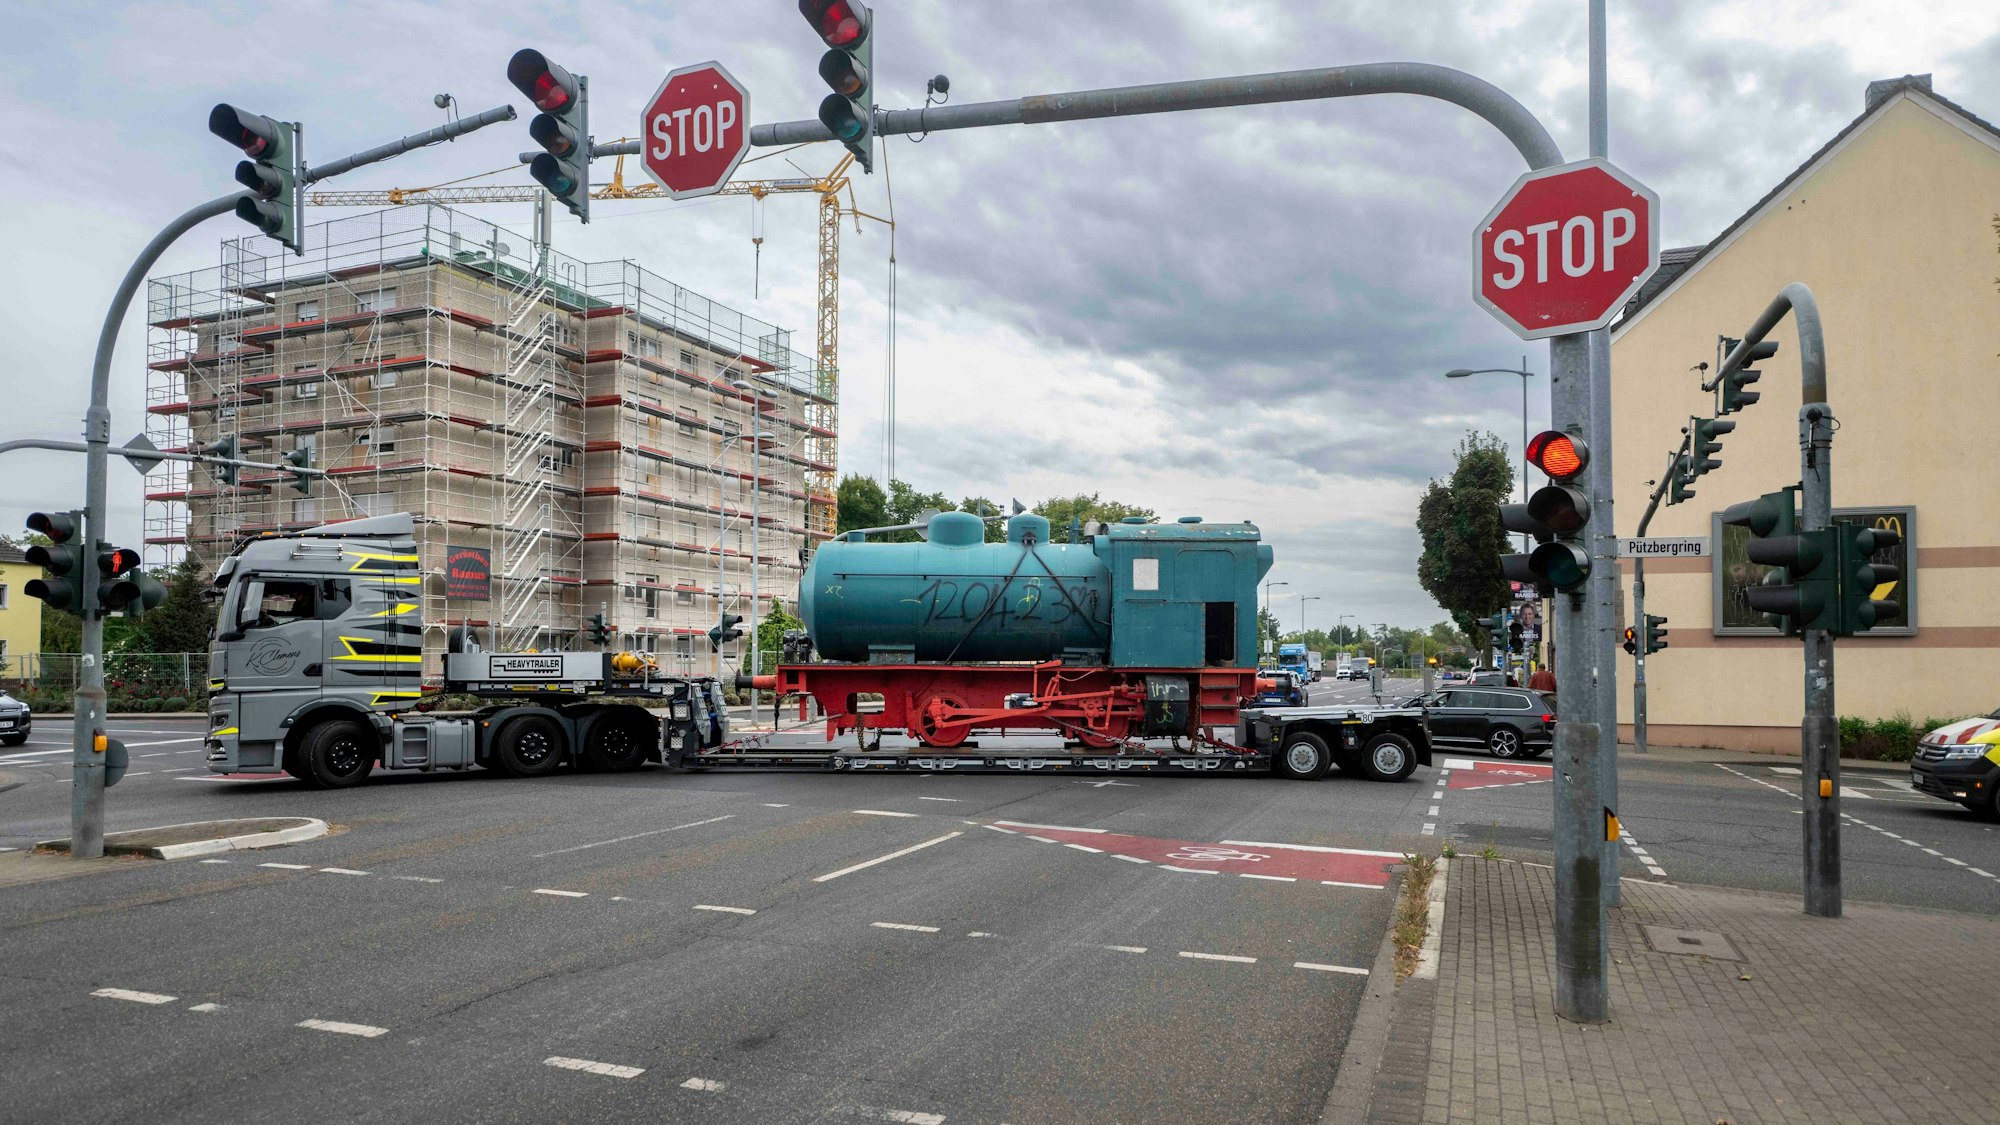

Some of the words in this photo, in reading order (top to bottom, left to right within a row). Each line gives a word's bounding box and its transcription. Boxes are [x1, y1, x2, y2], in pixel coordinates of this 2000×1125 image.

[652, 100, 736, 160] STOP
[1493, 208, 1636, 289] STOP
[1629, 540, 1701, 555] Pützbergring
[259, 649, 301, 666] Clemens
[507, 659, 559, 668] HEAVYTRAILER
[1362, 714, 1373, 723] 80
